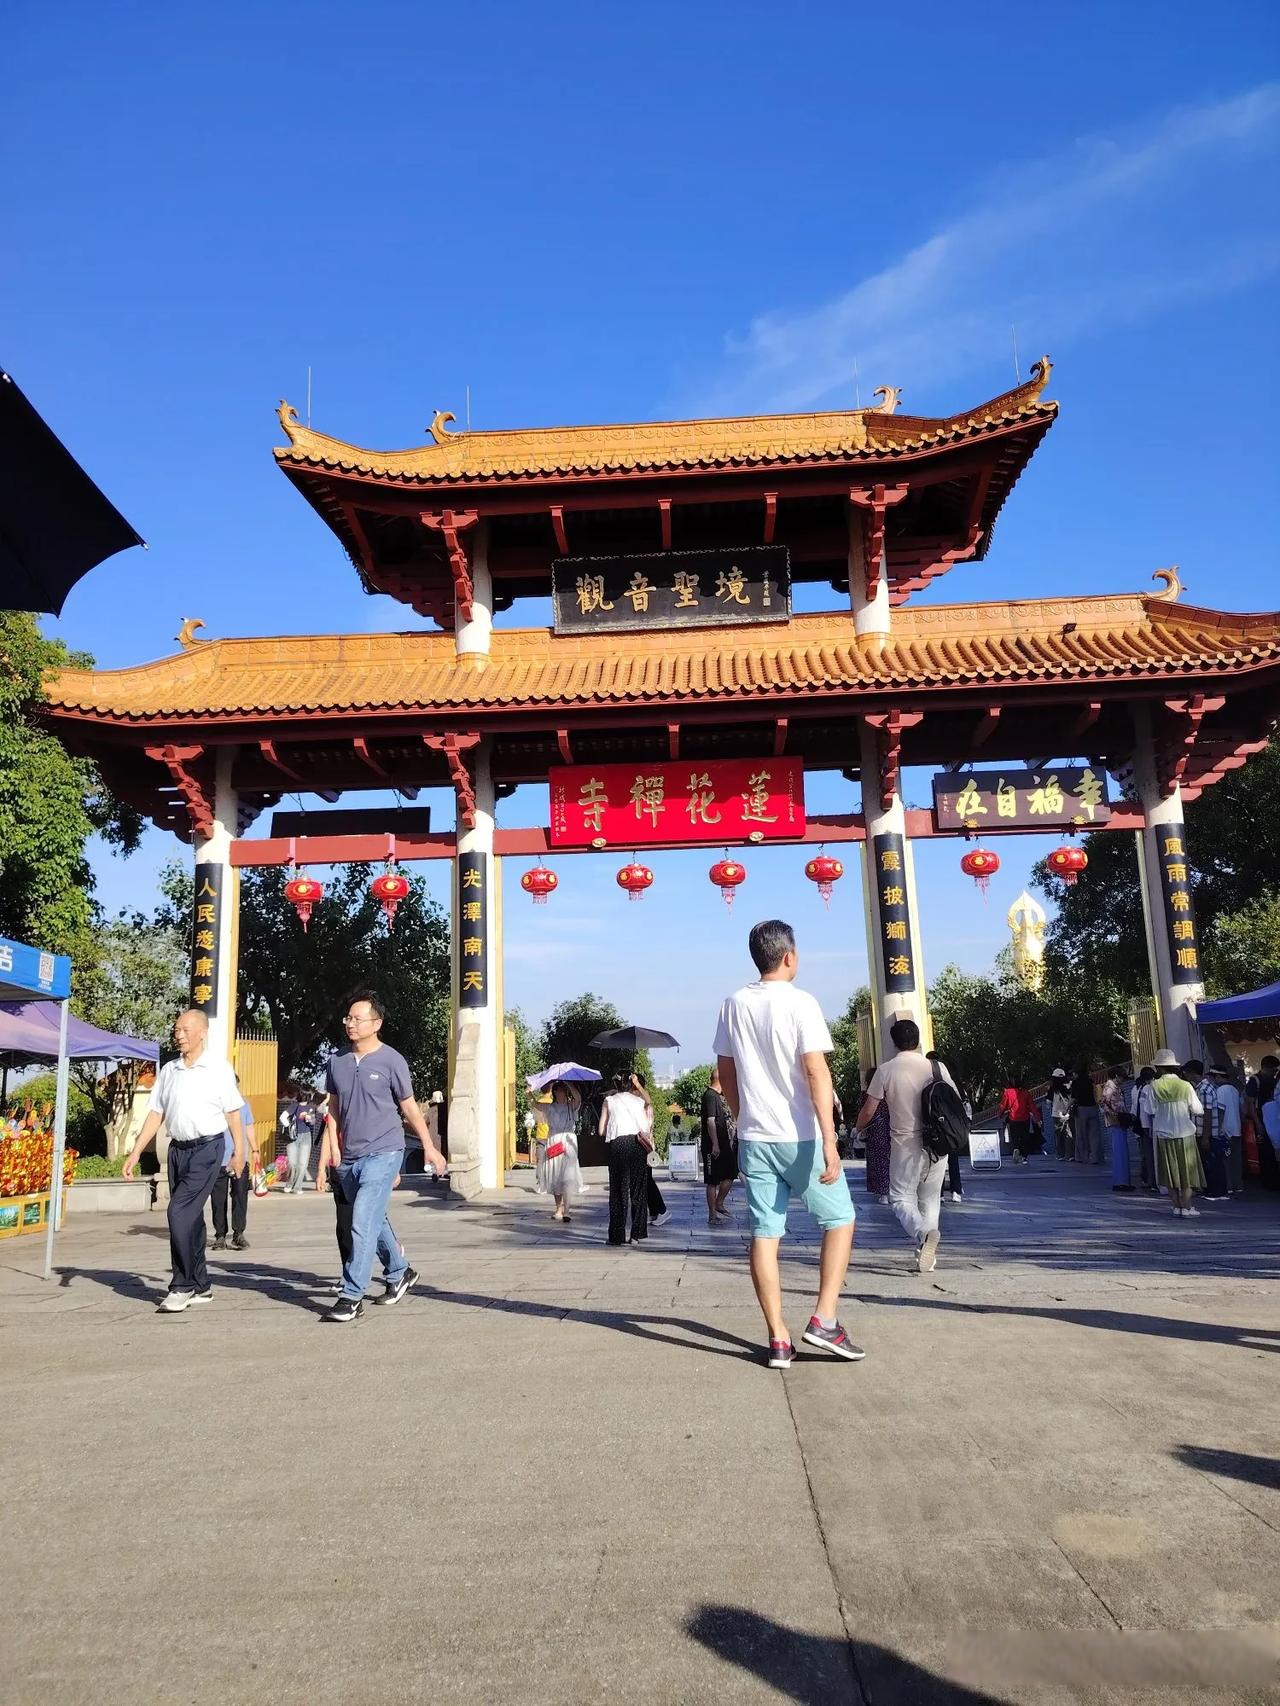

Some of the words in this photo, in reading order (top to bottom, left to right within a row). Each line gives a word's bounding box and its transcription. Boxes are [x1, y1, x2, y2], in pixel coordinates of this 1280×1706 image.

[575, 566, 751, 615] 觀音聖境
[578, 769, 779, 832] 蓮花禪寺
[956, 769, 1104, 820] 幸福自在
[463, 869, 484, 991] 光澤南天
[881, 851, 911, 975] 霞披獅海
[1164, 837, 1198, 969] 風雨常調順
